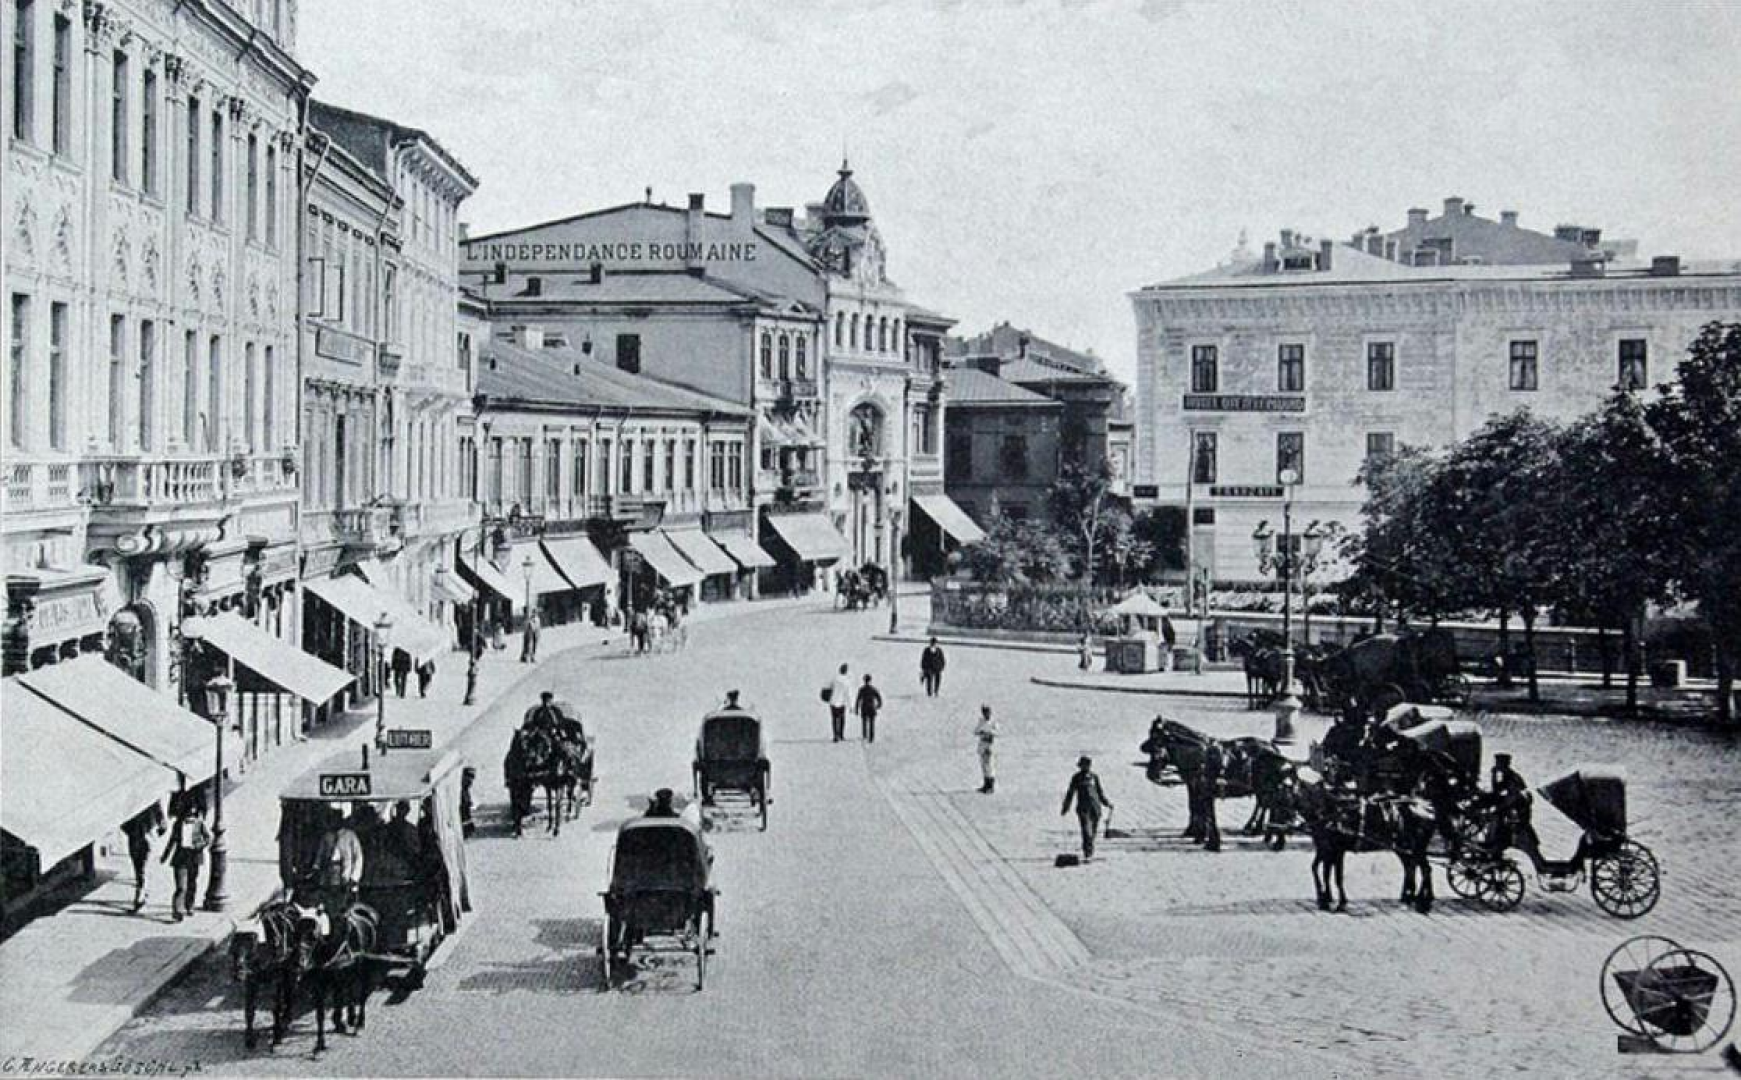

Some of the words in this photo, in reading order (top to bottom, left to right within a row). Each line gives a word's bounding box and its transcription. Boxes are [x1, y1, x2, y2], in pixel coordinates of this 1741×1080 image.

[467, 243, 642, 261] L'INDEPENDANCE
[650, 243, 757, 262] ROUMAINE
[322, 776, 368, 794] GARA
